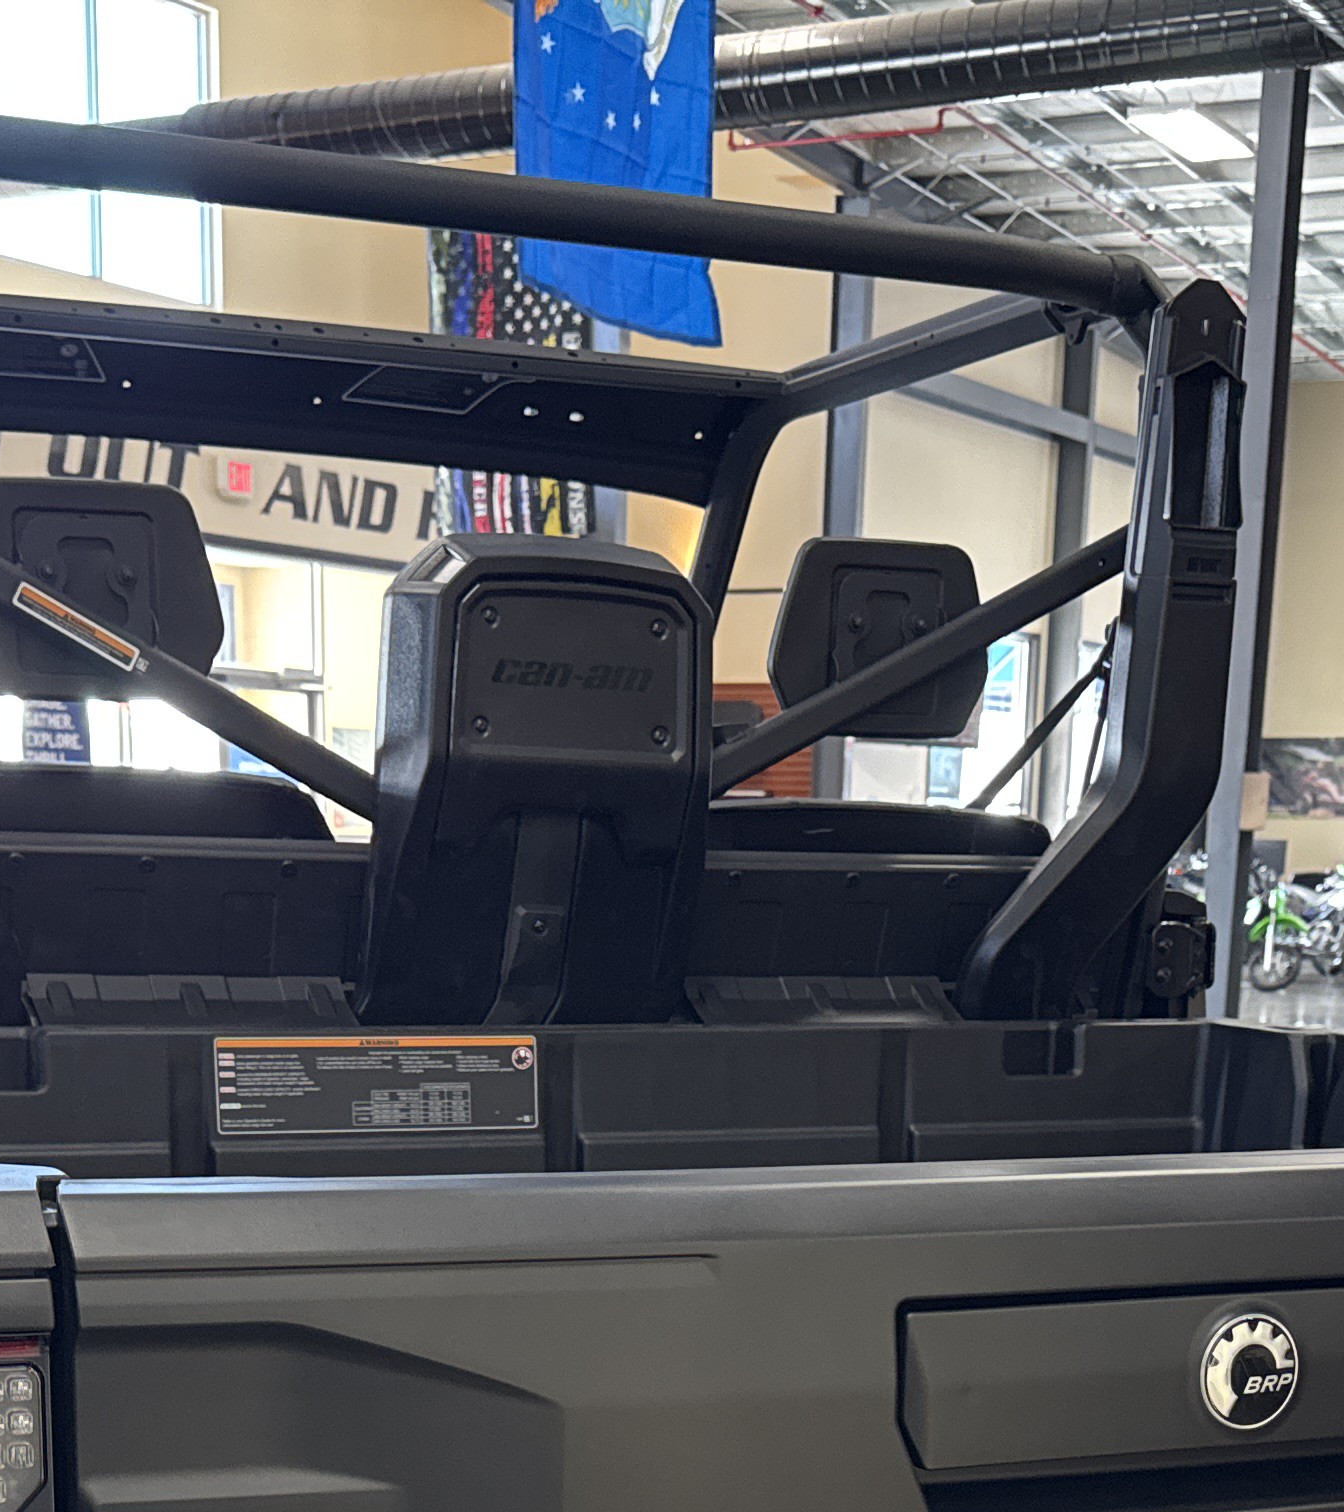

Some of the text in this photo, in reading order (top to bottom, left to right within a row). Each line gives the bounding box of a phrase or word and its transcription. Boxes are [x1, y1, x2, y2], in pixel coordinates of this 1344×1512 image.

[261, 463, 398, 533] AND
[490, 656, 654, 694] can-am
[1242, 1373, 1293, 1396] BRP
